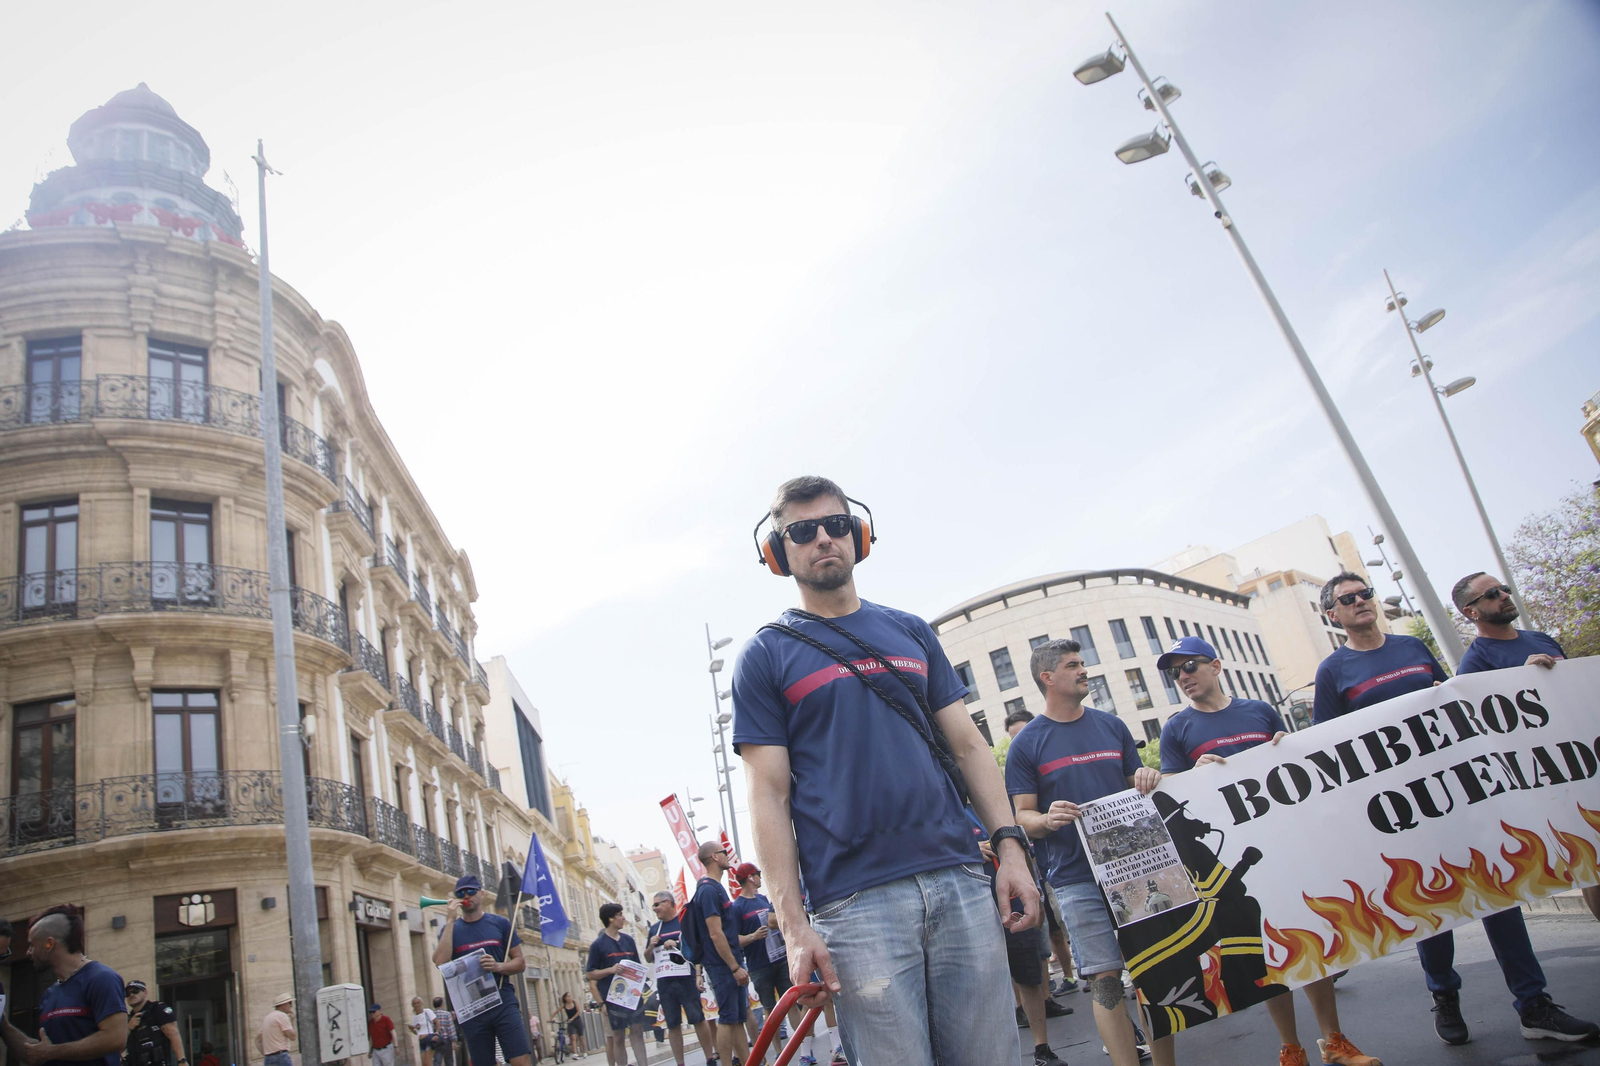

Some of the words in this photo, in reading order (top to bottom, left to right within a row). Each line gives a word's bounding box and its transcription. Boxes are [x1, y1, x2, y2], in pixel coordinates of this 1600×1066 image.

[1218, 688, 1549, 826] BOMBEROS
[1367, 735, 1600, 834] QUEMAD
[1081, 809, 1092, 818] EL
[1093, 794, 1145, 814] AYUNTAMIENTO
[1091, 806, 1131, 823] MALVERSA
[1130, 802, 1144, 811] LOS
[1091, 818, 1122, 832] FONDOS
[1104, 873, 1131, 887] PARQUE
[1131, 869, 1142, 878] DE
[1142, 857, 1178, 875] BOMBEROS
[1105, 858, 1128, 870] HACEN
[1129, 852, 1146, 862] CAJA
[1115, 862, 1141, 876] DINERO
[1142, 858, 1152, 866] NO
